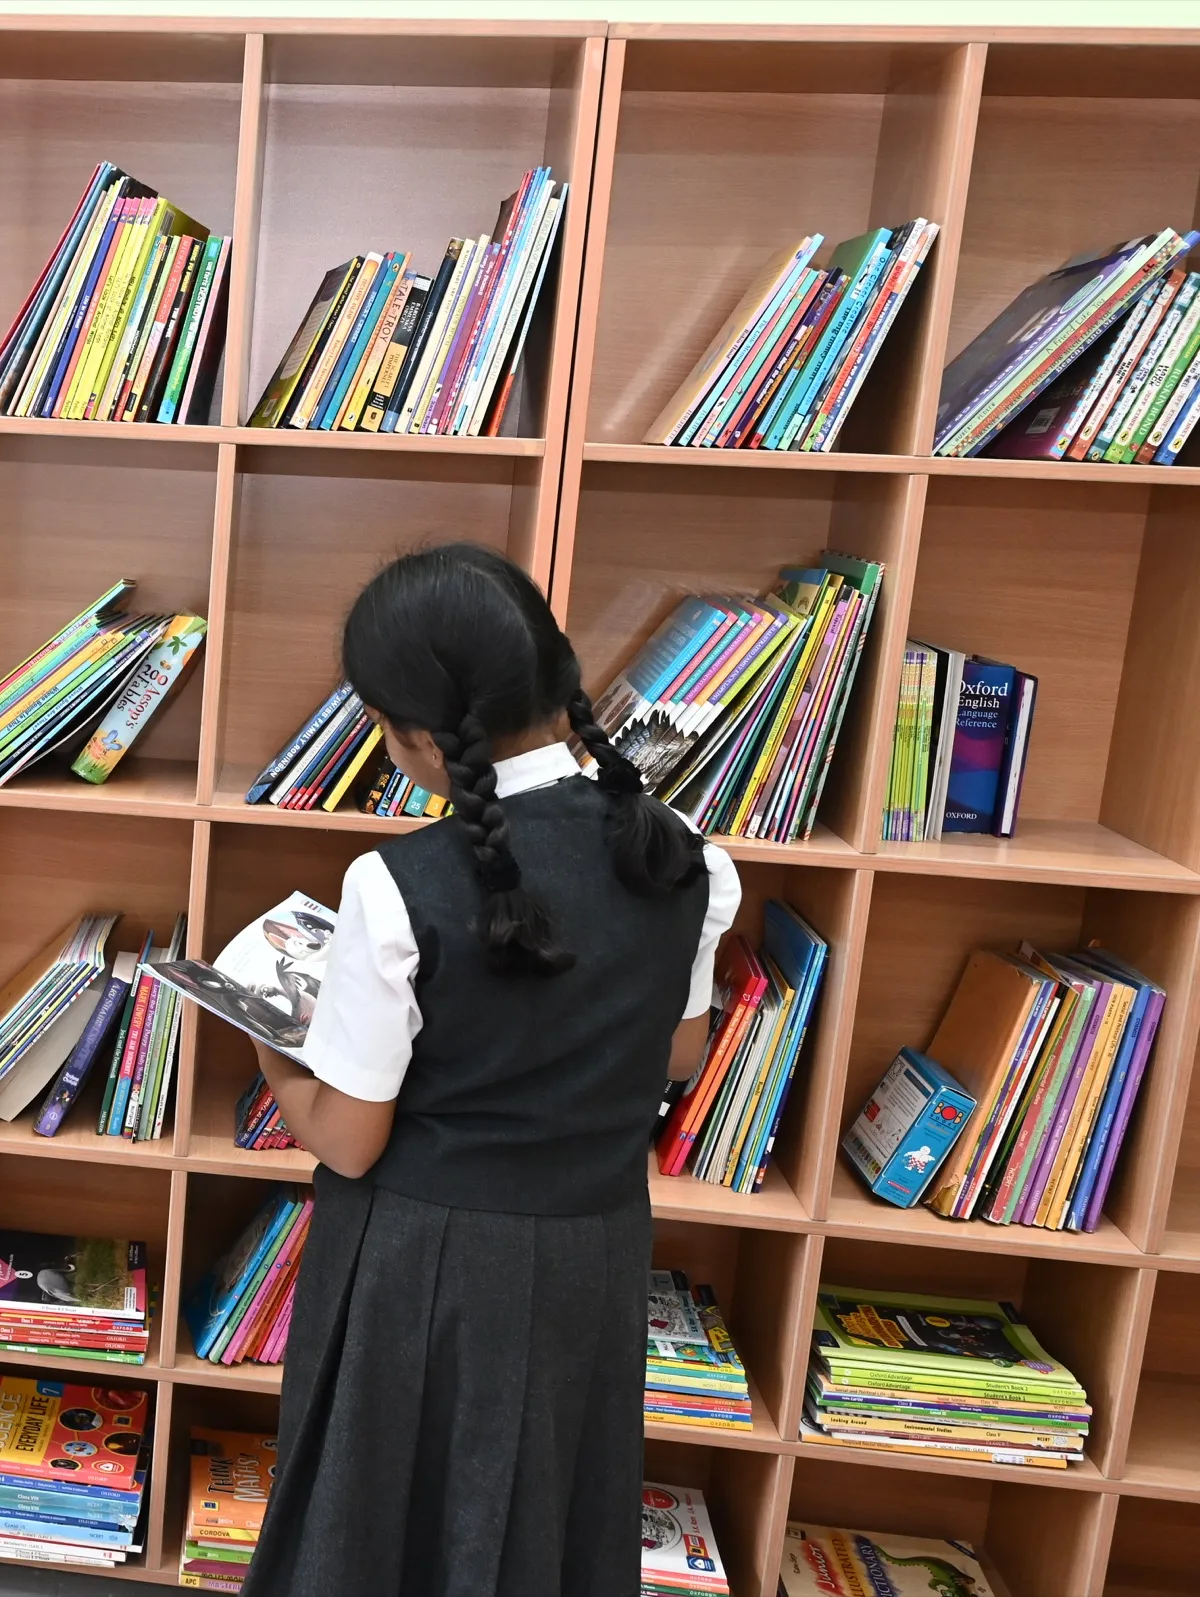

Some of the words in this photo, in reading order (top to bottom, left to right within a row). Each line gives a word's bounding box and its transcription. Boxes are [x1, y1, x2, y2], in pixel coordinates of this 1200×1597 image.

[172, 238, 189, 275] MICHAEL
[872, 255, 886, 274] One
[391, 283, 408, 310] TALE
[859, 272, 877, 300] Clever
[378, 313, 397, 343] TROY
[841, 299, 863, 335] Creature
[1051, 321, 1078, 349] Friend
[1073, 306, 1093, 327] Like
[734, 326, 749, 346] Robin
[724, 343, 738, 360] Hood
[1146, 363, 1165, 387] LUCK
[1151, 365, 1184, 407] RUSKIN
[1152, 364, 1171, 387] HARD
[1135, 405, 1160, 436] BOND
[749, 625, 776, 656] ILLUSTRATED
[736, 653, 753, 671] FAMILY
[140, 662, 169, 687] 200
[710, 668, 740, 702] ENCYCLOPEDIA
[115, 673, 150, 715] Fables
[958, 695, 999, 708] English
[120, 681, 162, 731] Aesop's
[297, 716, 322, 745] FAMILY
[269, 742, 300, 778] ROBINSON
[410, 801, 421, 809] 25
[135, 984, 151, 1004] MARK
[126, 1002, 149, 1029] LOWERY
[1088, 1013, 1100, 1035] COSMOS
[1130, 1017, 1141, 1038] COSMOS
[1146, 1020, 1157, 1042] COSMOS
[753, 1080, 763, 1096] Bambi
[1002, 1166, 1017, 1189] NCERT
[866, 1379, 884, 1388] Oxford
[883, 1381, 911, 1392] Advantage
[868, 1370, 886, 1380] Oxford
[885, 1371, 913, 1383] Advantage
[985, 1380, 1010, 1391] Student's
[1009, 1384, 1024, 1393] Book
[41, 1386, 60, 1395] 7
[983, 1390, 1008, 1401] Student's
[1008, 1393, 1022, 1402] Book
[1052, 1388, 1077, 1397] OXFORD
[28, 1395, 50, 1416] LIFE
[829, 1416, 849, 1425] Looking
[849, 1418, 867, 1427] Around
[903, 1422, 935, 1434] Environmental
[935, 1426, 953, 1435] Studies
[14, 1413, 45, 1453] EVERYDAY
[1036, 1435, 1051, 1444] NCERT
[208, 1456, 234, 1494] THINK
[233, 1452, 268, 1503] MATHS!
[199, 1529, 230, 1537] CORDOVA
[185, 1577, 197, 1585] APC
